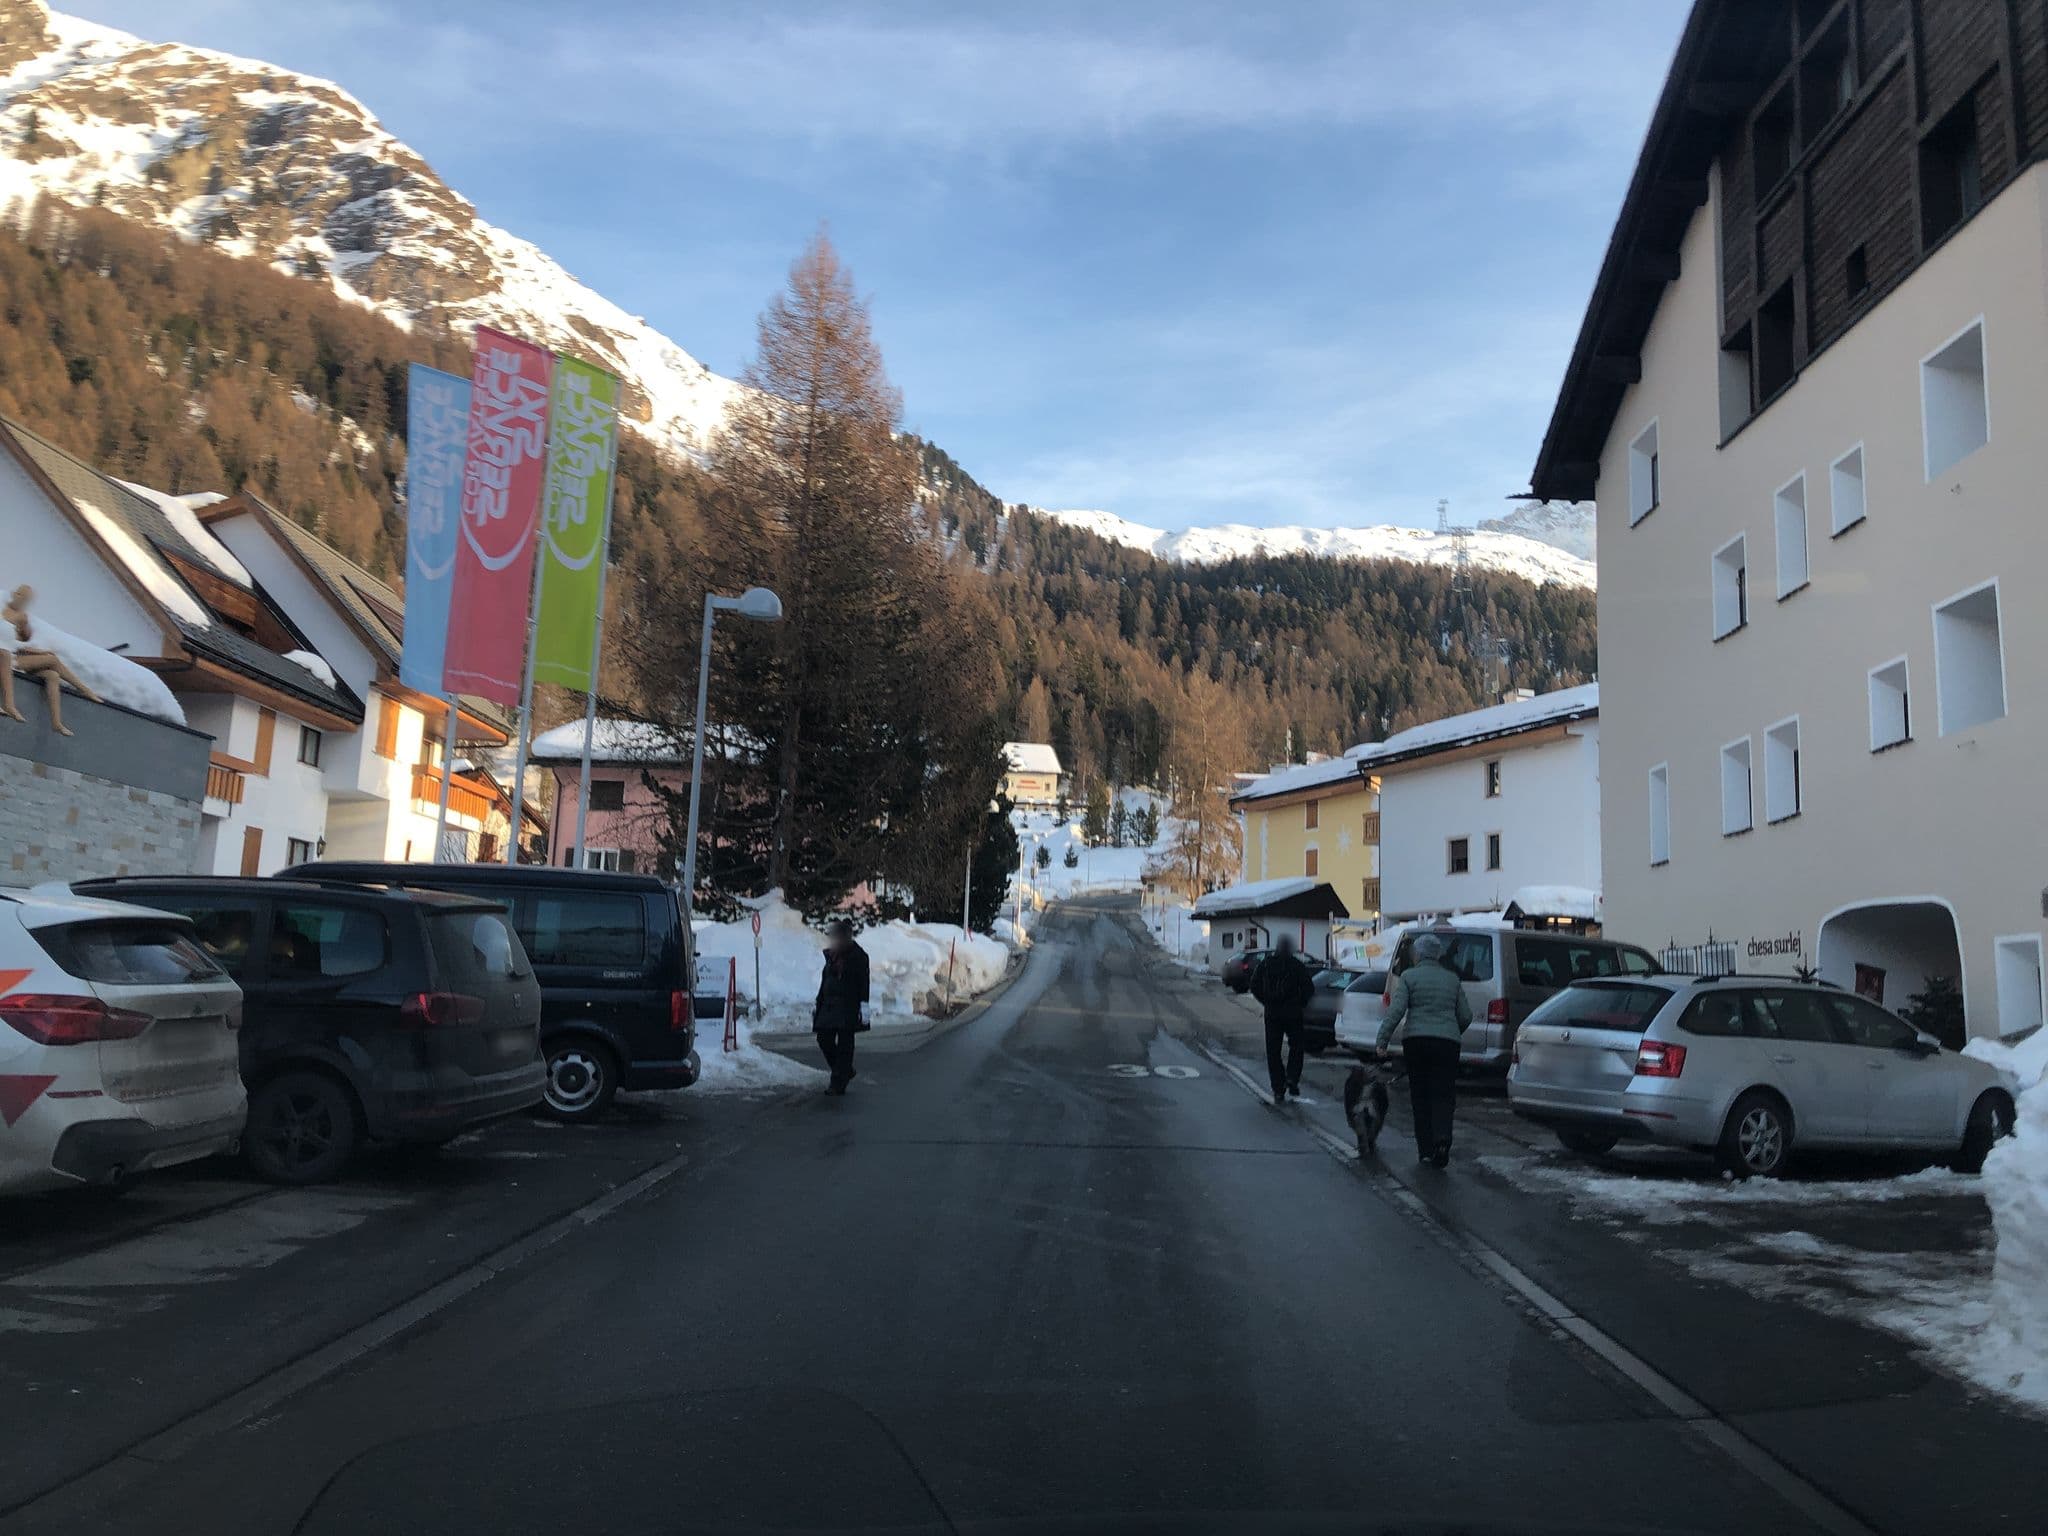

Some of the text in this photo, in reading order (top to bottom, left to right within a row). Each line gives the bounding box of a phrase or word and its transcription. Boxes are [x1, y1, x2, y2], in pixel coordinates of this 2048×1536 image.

[1747, 931, 1801, 958] chesa surlej
[1106, 1063, 1200, 1079] 30
